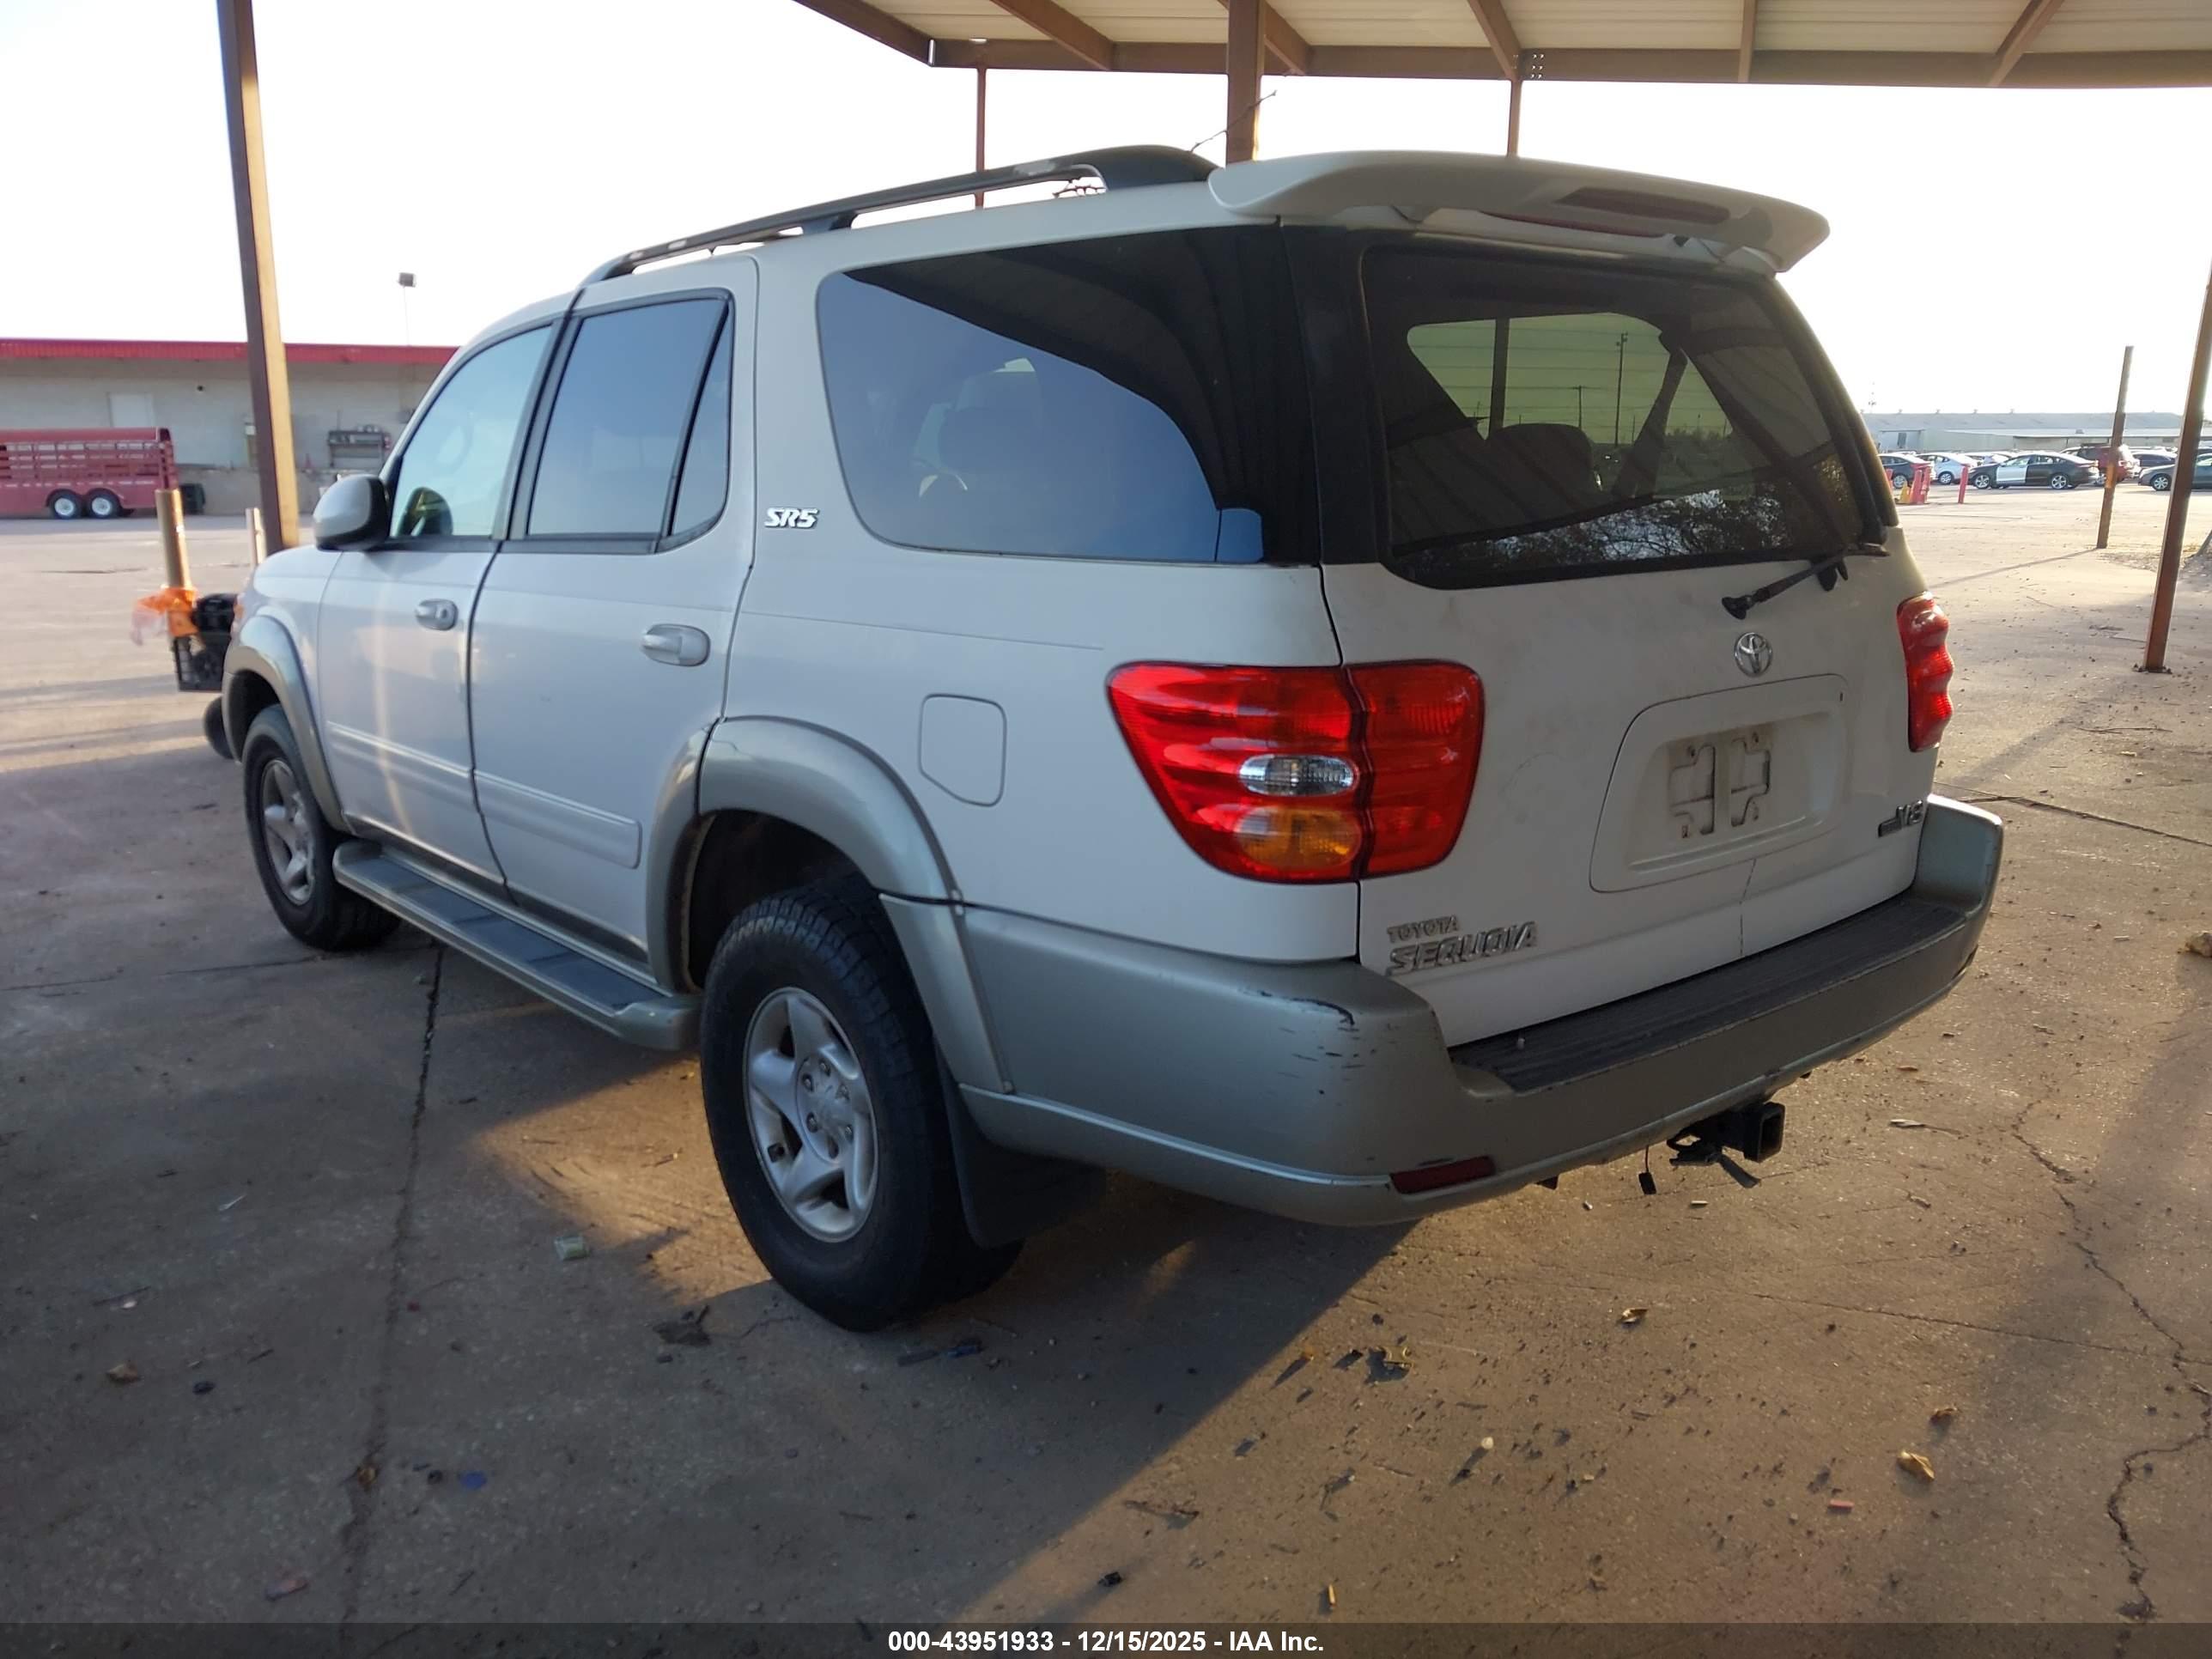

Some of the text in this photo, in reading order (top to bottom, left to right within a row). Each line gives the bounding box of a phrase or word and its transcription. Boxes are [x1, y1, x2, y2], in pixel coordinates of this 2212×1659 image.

[764, 507, 820, 529] SR5
[1387, 915, 1459, 943] TOYOTA
[1386, 921, 1539, 976] SEQUOIA
